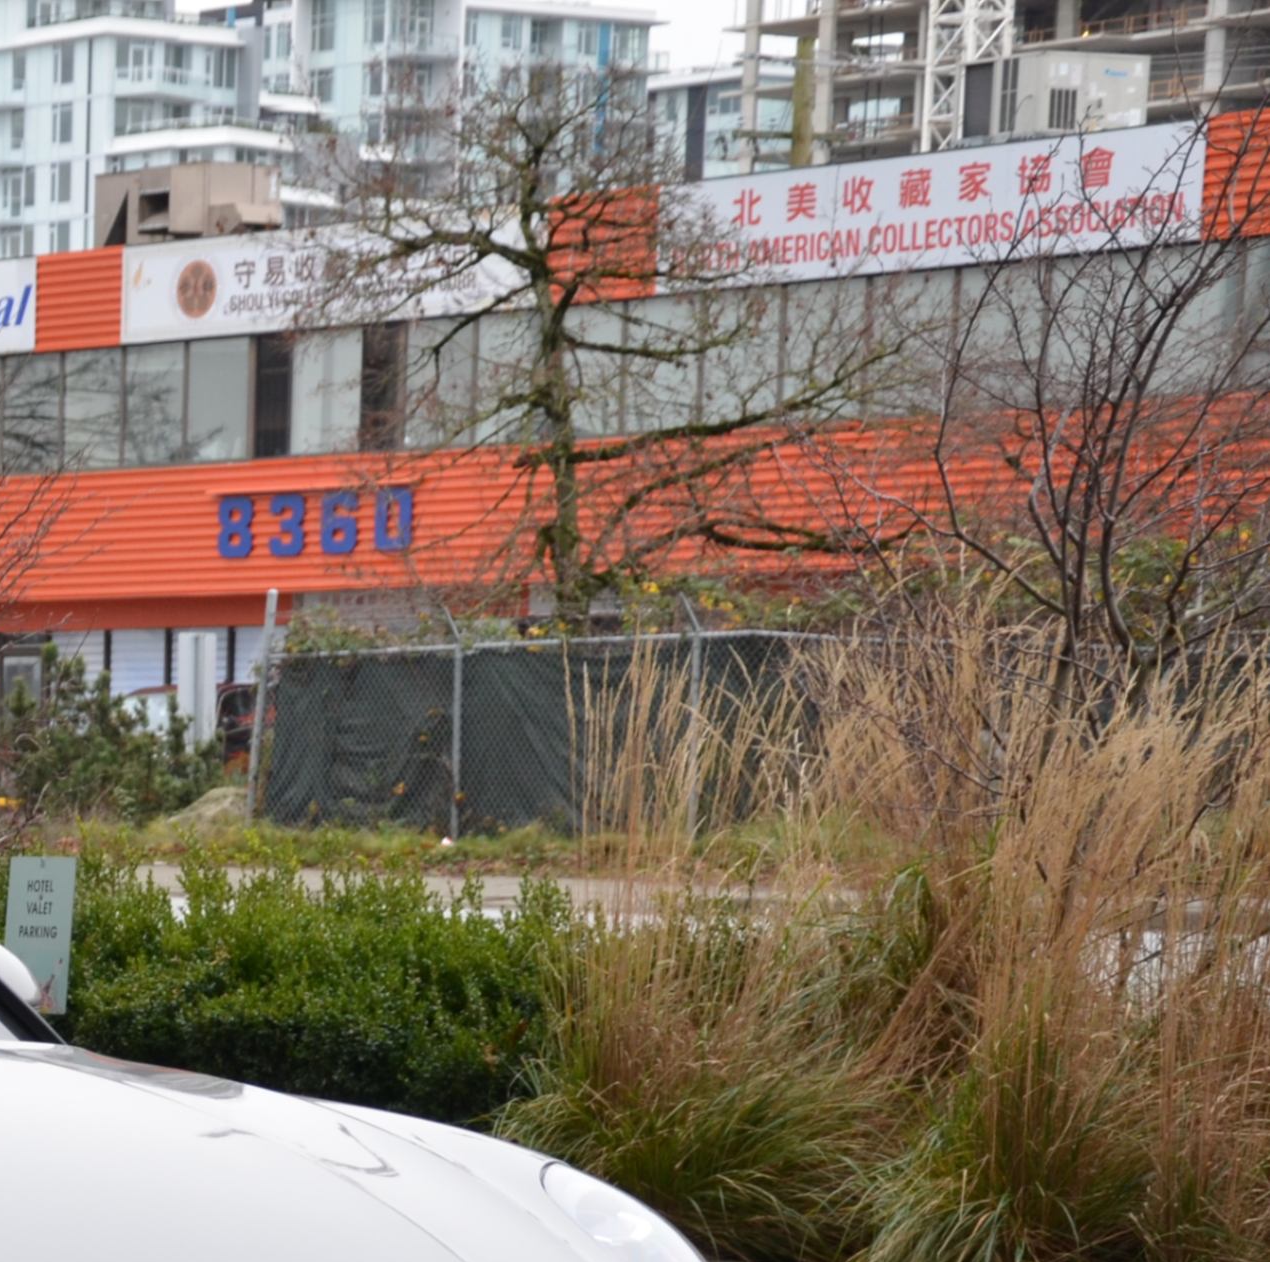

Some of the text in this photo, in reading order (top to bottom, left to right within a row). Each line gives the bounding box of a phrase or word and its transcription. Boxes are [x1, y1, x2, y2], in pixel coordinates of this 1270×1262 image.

[730, 146, 1115, 227] 北美收藏家協會
[748, 228, 861, 267] AMERICAN
[867, 210, 1014, 256] COLLECTORS
[1020, 191, 1185, 240] ASSOCIATION
[218, 486, 414, 558] 8360
[26, 880, 54, 893] HOTEL
[26, 902, 53, 915] VALET
[18, 925, 58, 938] PARKING
